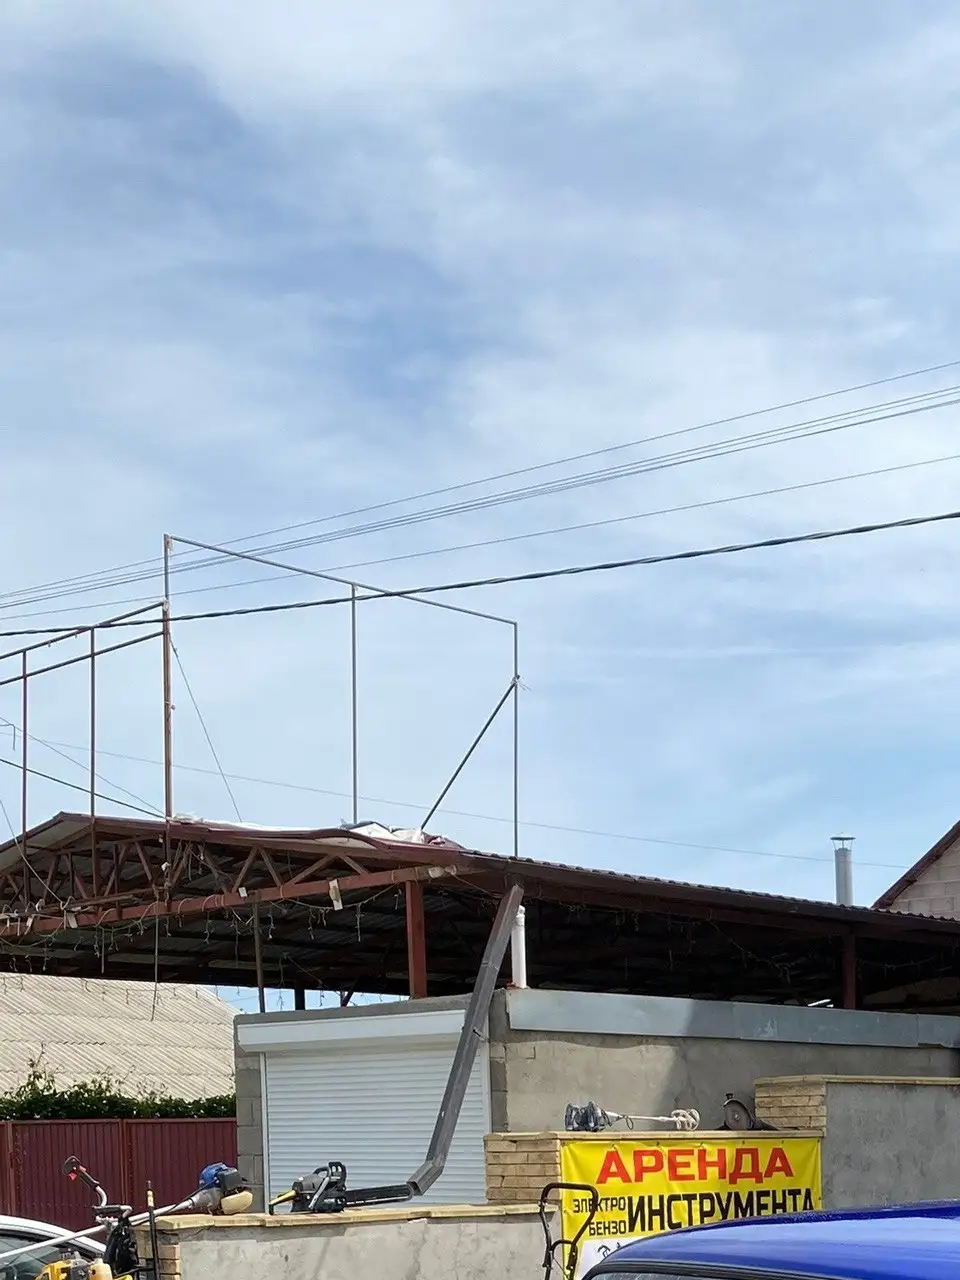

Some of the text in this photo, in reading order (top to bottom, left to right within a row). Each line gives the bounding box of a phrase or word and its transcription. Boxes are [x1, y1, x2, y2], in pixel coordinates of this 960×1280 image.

[596, 1147, 794, 1185] АРЕНДА
[589, 1220, 627, 1236] БЕНЗО
[627, 1187, 815, 1233] ИНСТРУМЕНТА
